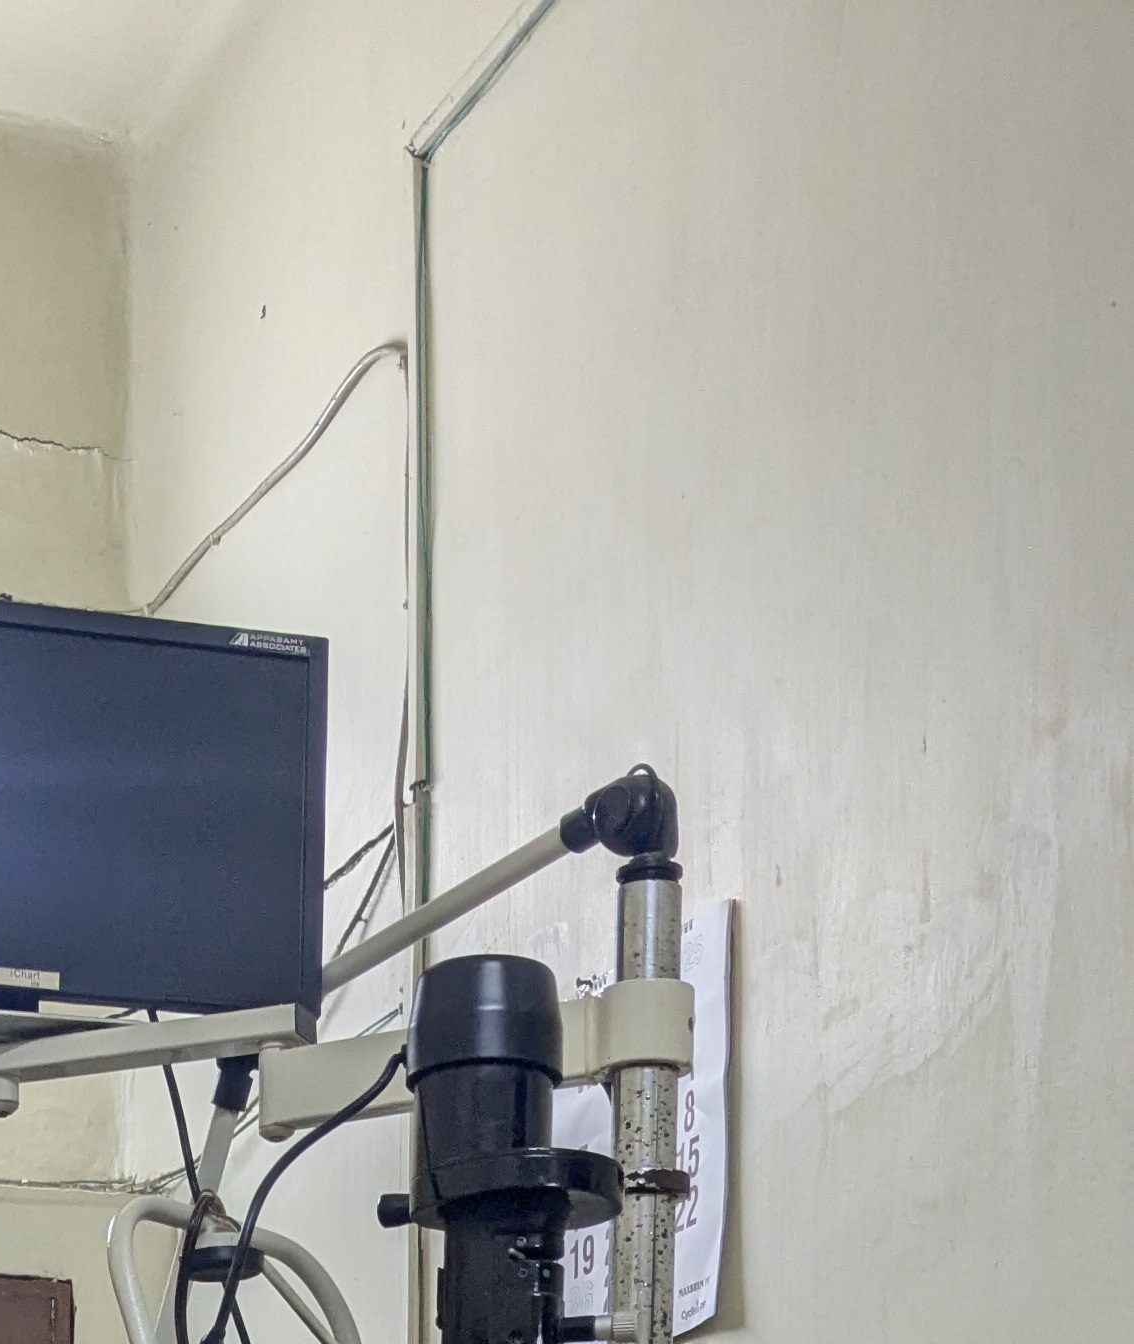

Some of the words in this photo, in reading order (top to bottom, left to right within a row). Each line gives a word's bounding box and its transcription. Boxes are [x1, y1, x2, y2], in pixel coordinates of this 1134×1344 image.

[249, 633, 304, 645] APPASAMY
[249, 641, 307, 653] ASSOCIATES
[10, 969, 40, 980] iChart
[684, 1089, 695, 1133] 8
[570, 1234, 595, 1279] 19
